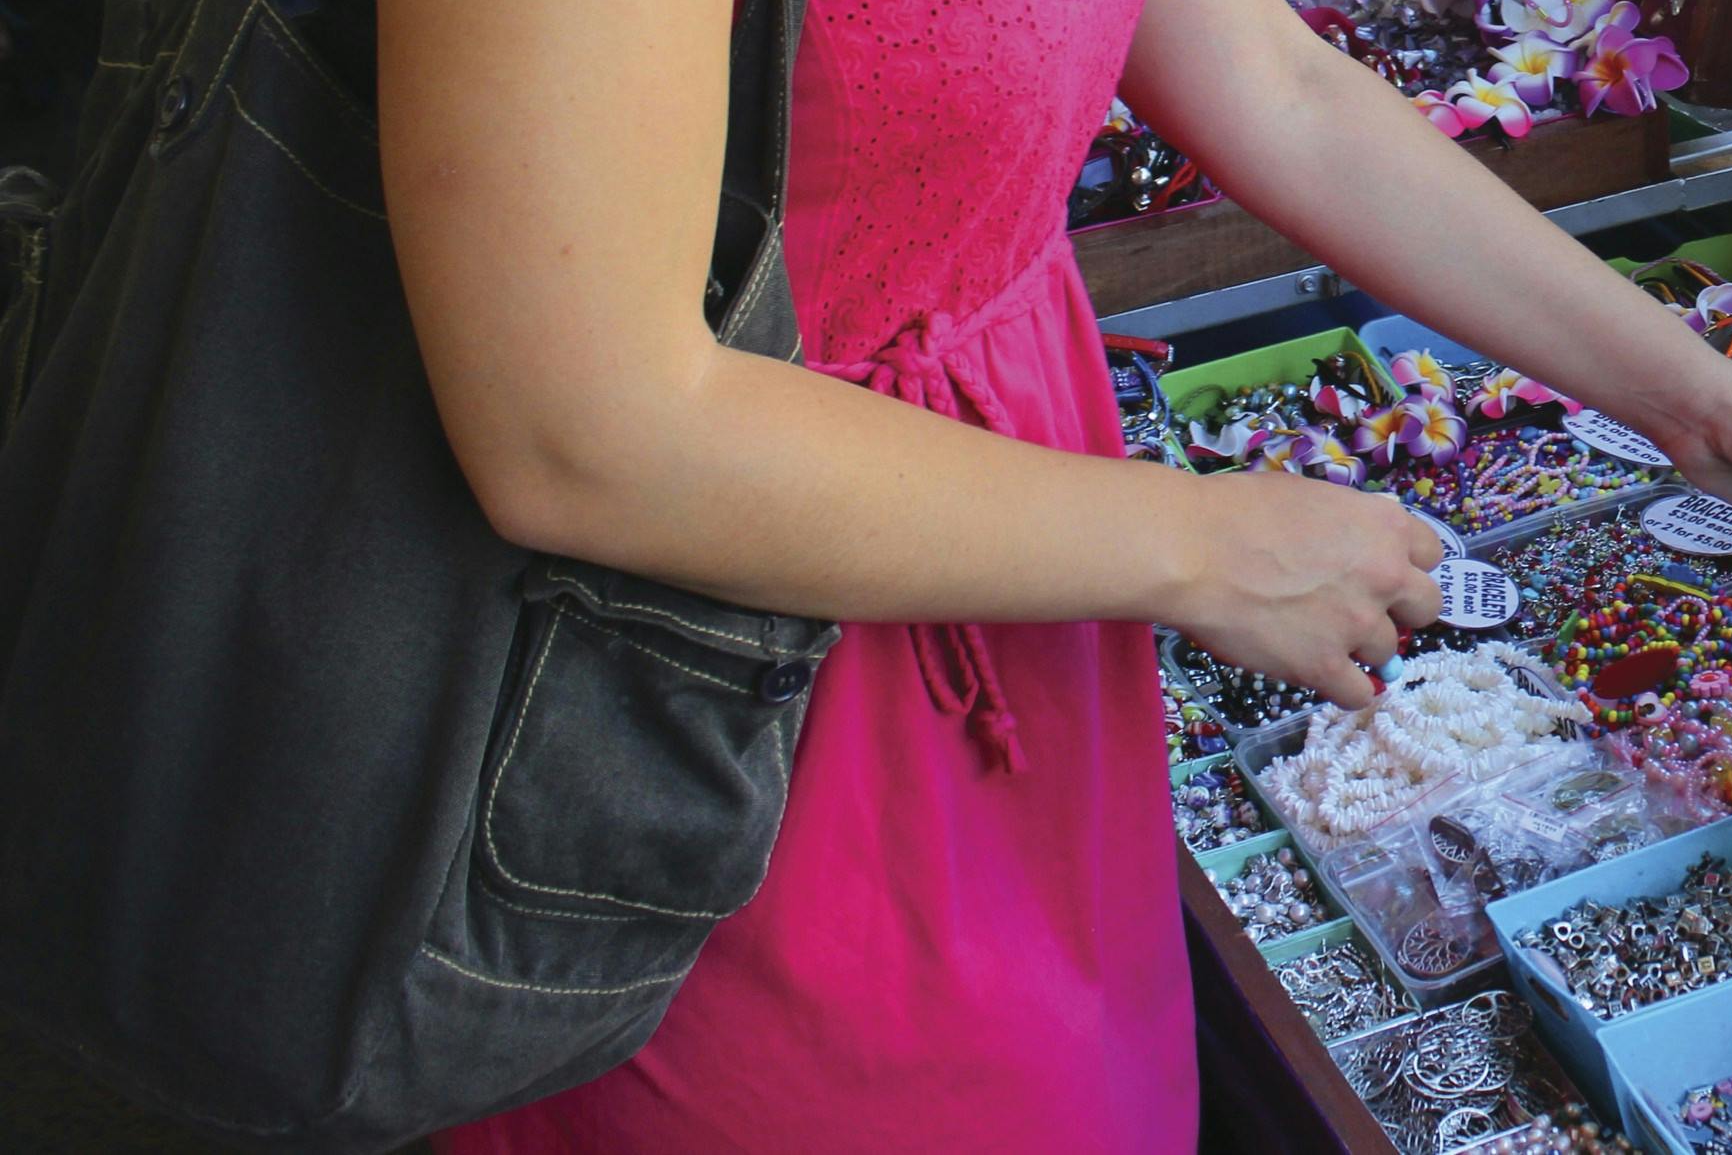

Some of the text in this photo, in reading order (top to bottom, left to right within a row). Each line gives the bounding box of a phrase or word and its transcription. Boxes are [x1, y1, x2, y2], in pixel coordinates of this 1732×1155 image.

[1589, 419, 1628, 438] $3.00
[1567, 421, 1583, 429] or
[1597, 434, 1618, 444] for
[1619, 444, 1661, 463] $5.00
[1668, 509, 1707, 526] $3.00
[1645, 518, 1662, 526] or
[1660, 523, 1673, 531] 2
[1672, 527, 1694, 538] for
[1440, 564, 1451, 573] or
[1440, 582, 1454, 593] for
[1464, 572, 1479, 614] $3.00 each
[1481, 571, 1506, 620] BRACELETS
